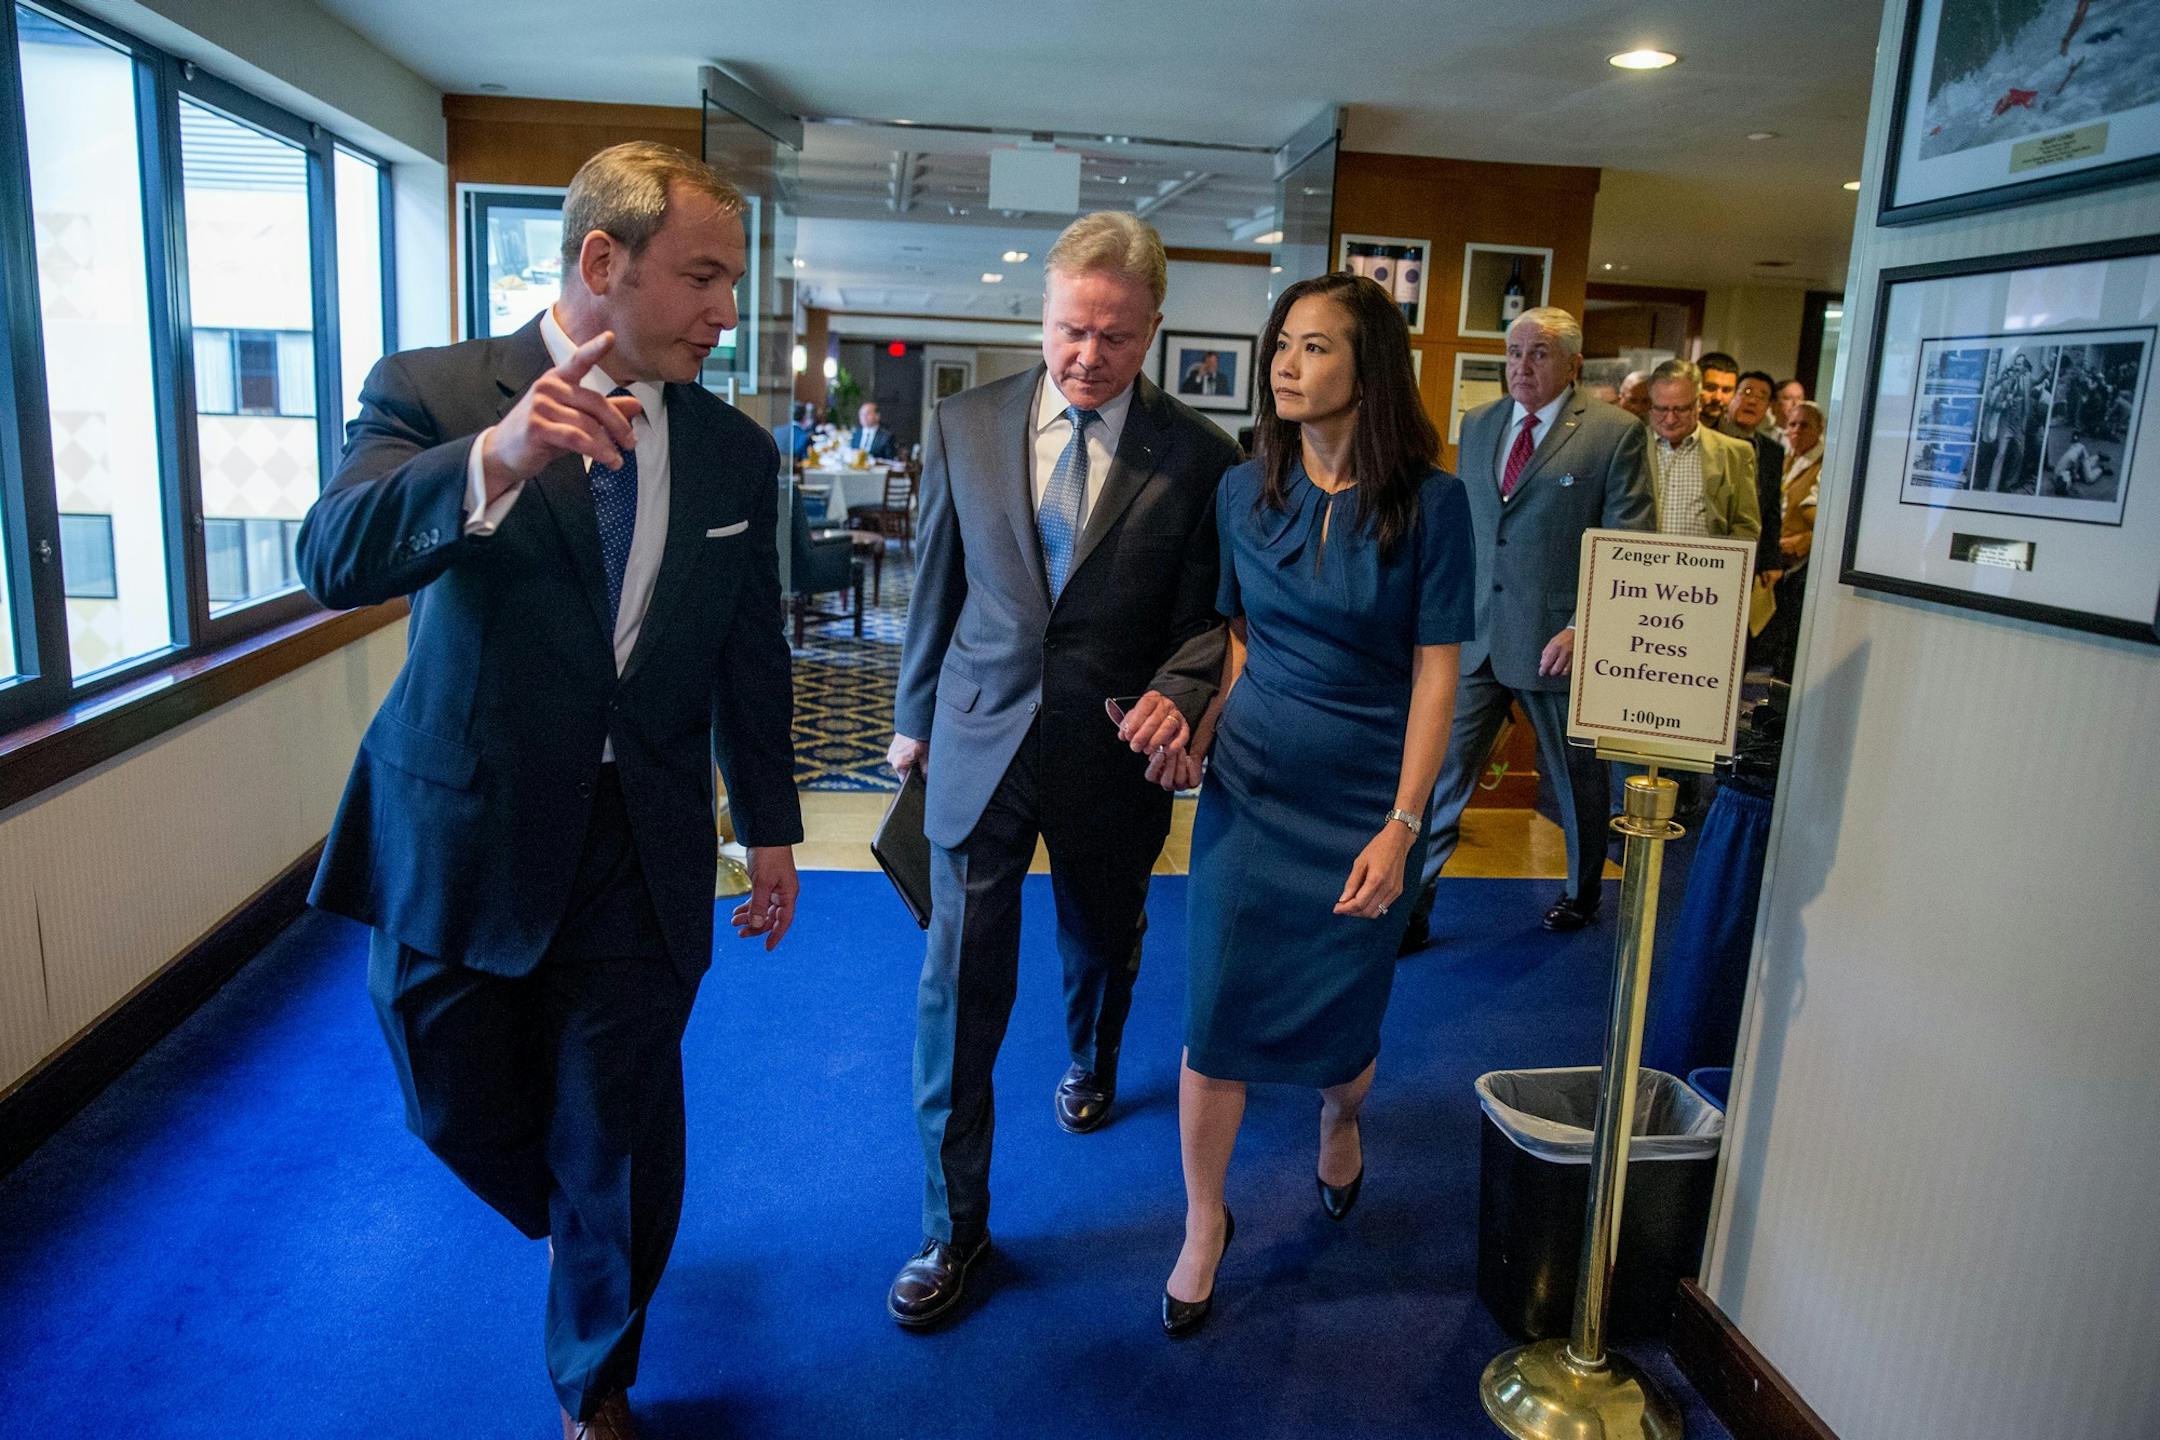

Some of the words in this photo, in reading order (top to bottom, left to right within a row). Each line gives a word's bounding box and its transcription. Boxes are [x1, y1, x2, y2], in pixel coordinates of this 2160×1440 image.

[1611, 546, 1670, 567] Zenger
[1676, 551, 1725, 569] Room
[1610, 579, 1648, 600] Jim
[1655, 583, 1719, 605] Webb
[1637, 613, 1684, 630] 2016
[1630, 636, 1688, 658] Press
[1594, 658, 1719, 689] Conference
[1621, 708, 1681, 729] 1:00pm
